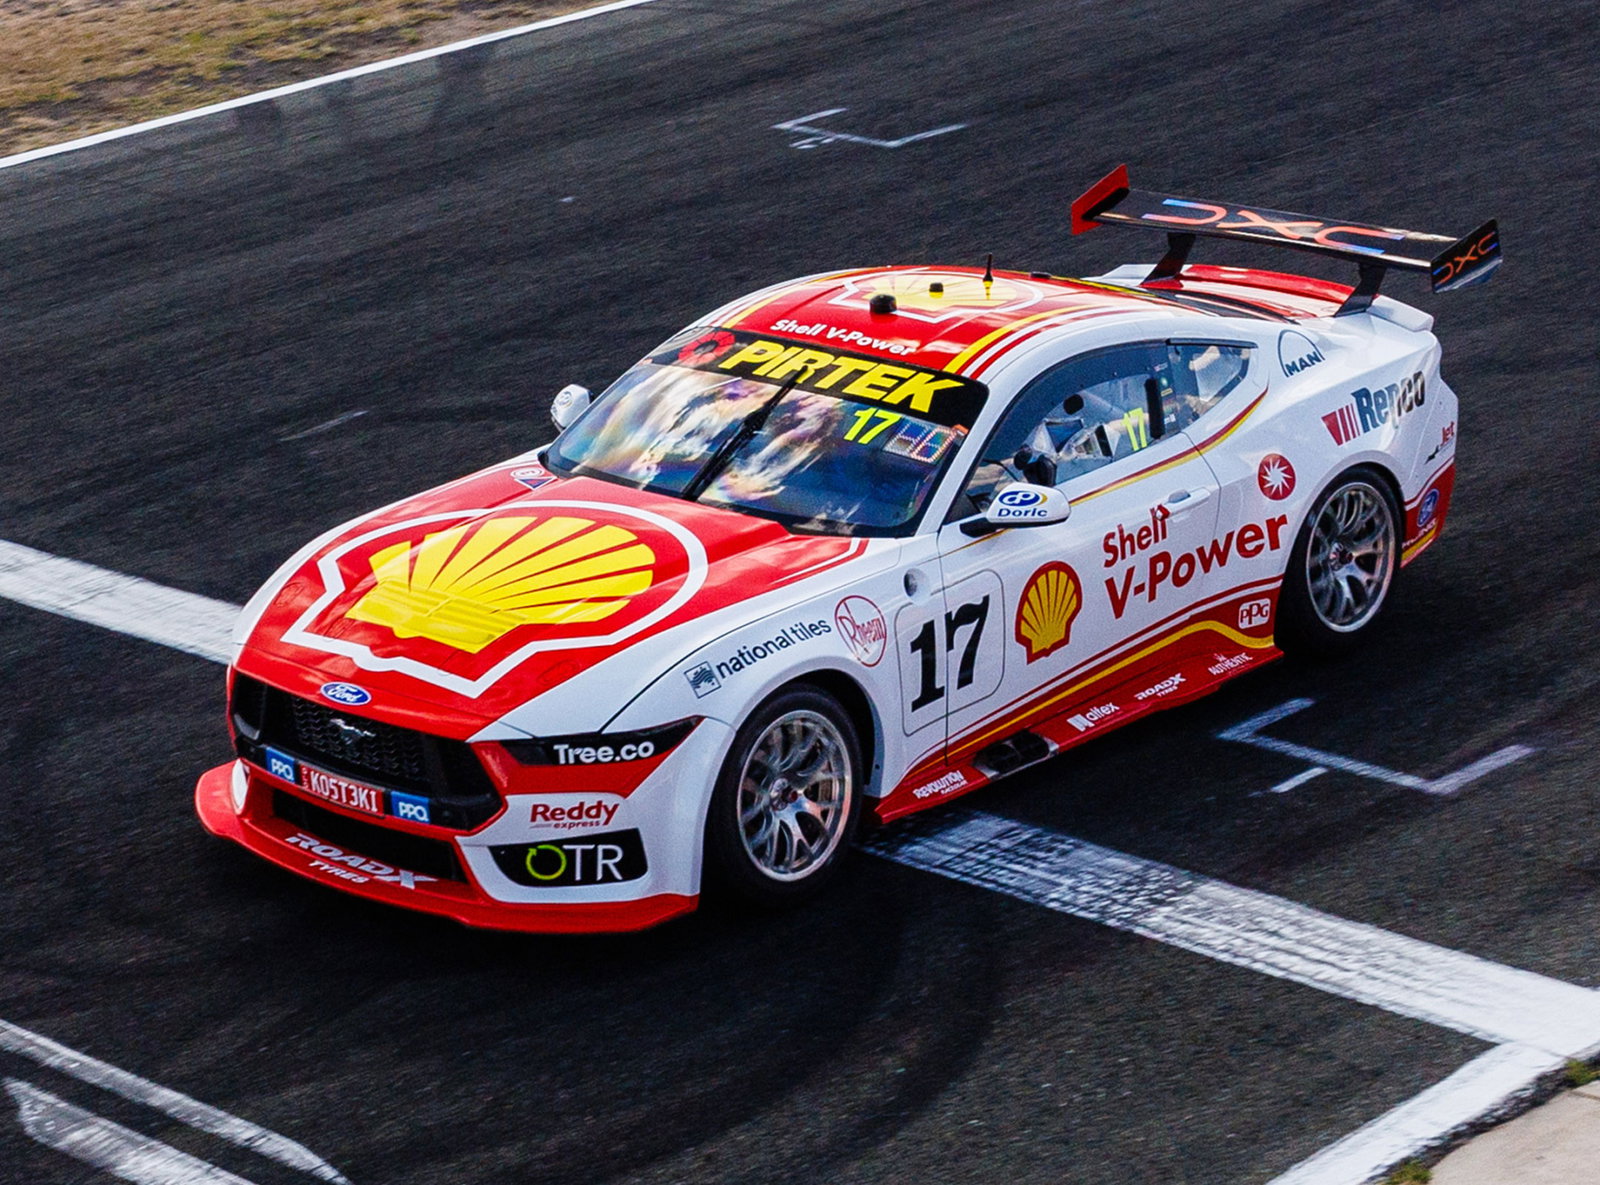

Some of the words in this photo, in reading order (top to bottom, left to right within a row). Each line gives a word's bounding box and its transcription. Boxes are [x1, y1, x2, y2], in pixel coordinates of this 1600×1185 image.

[770, 318, 828, 337] Shell
[827, 325, 917, 357] V-Power
[718, 339, 964, 414] PIRTEK
[1285, 350, 1321, 377] MAN
[1351, 370, 1426, 433] Repco
[844, 406, 903, 445] 17
[1121, 407, 1148, 451] 17
[997, 507, 1048, 517] Doric
[1103, 505, 1168, 567] Shell
[1105, 512, 1288, 620] V-Power
[1240, 602, 1270, 626] PPG
[716, 629, 796, 680] national
[792, 618, 832, 643] tiles
[910, 594, 991, 712] 17
[327, 684, 364, 703] Ford
[1134, 672, 1187, 700] ROADX
[552, 741, 655, 766] Tree.co
[529, 800, 620, 826] Reddy
[553, 821, 601, 830] express
[284, 832, 440, 891] ROADX
[309, 859, 371, 884] TYRES
[525, 844, 624, 881] OTR
